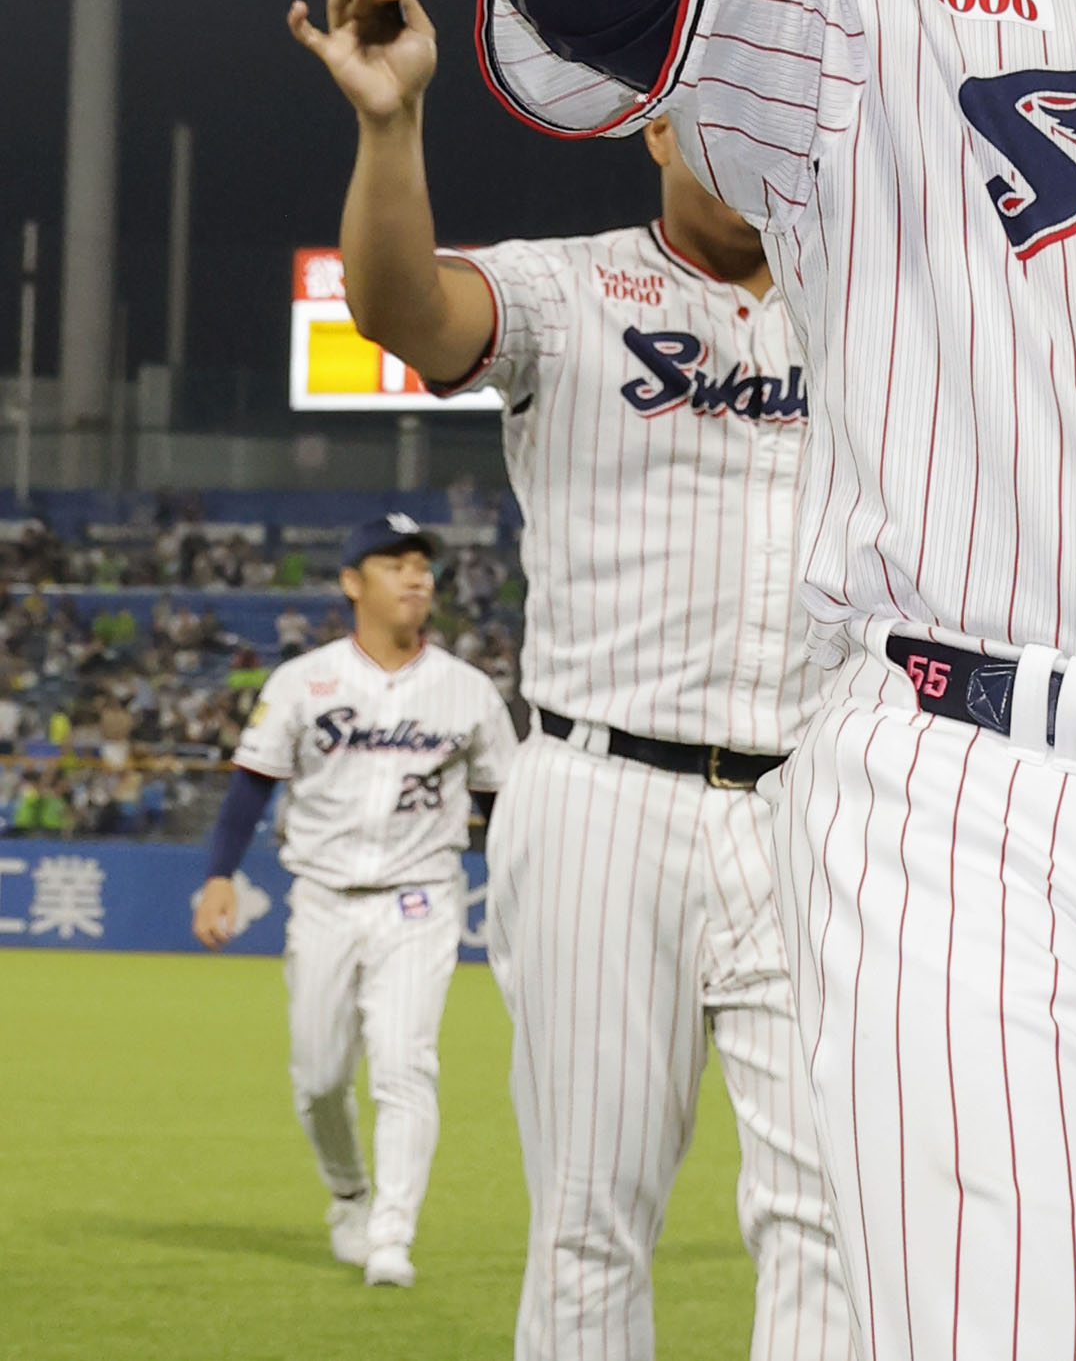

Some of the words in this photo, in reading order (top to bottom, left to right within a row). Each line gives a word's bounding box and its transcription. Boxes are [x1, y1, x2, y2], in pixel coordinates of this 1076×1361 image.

[595, 264, 665, 289] Yakult
[603, 282, 663, 307] 1000
[907, 654, 952, 699] 55
[314, 706, 466, 757] Swallows
